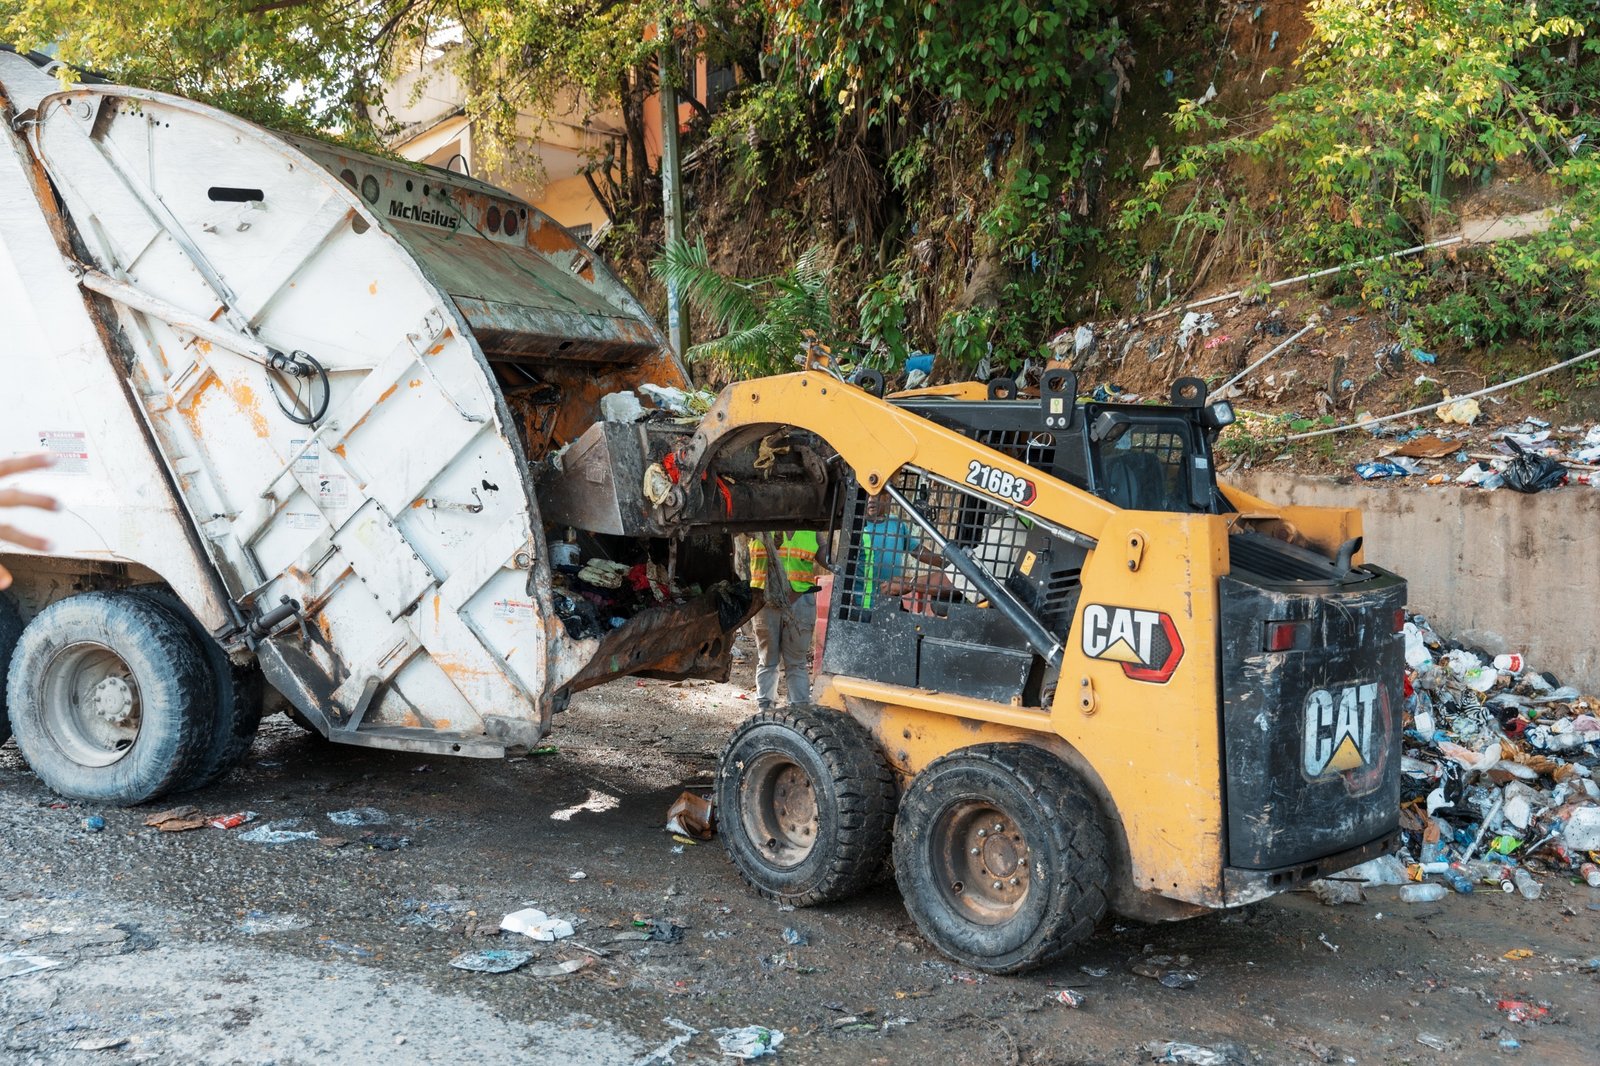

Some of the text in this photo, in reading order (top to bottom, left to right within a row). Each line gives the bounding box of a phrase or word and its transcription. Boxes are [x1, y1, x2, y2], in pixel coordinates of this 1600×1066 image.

[389, 200, 457, 229] McNeilus
[966, 460, 1027, 502] 216B3
[1083, 604, 1159, 665] CAT
[1305, 682, 1378, 776] CAT
